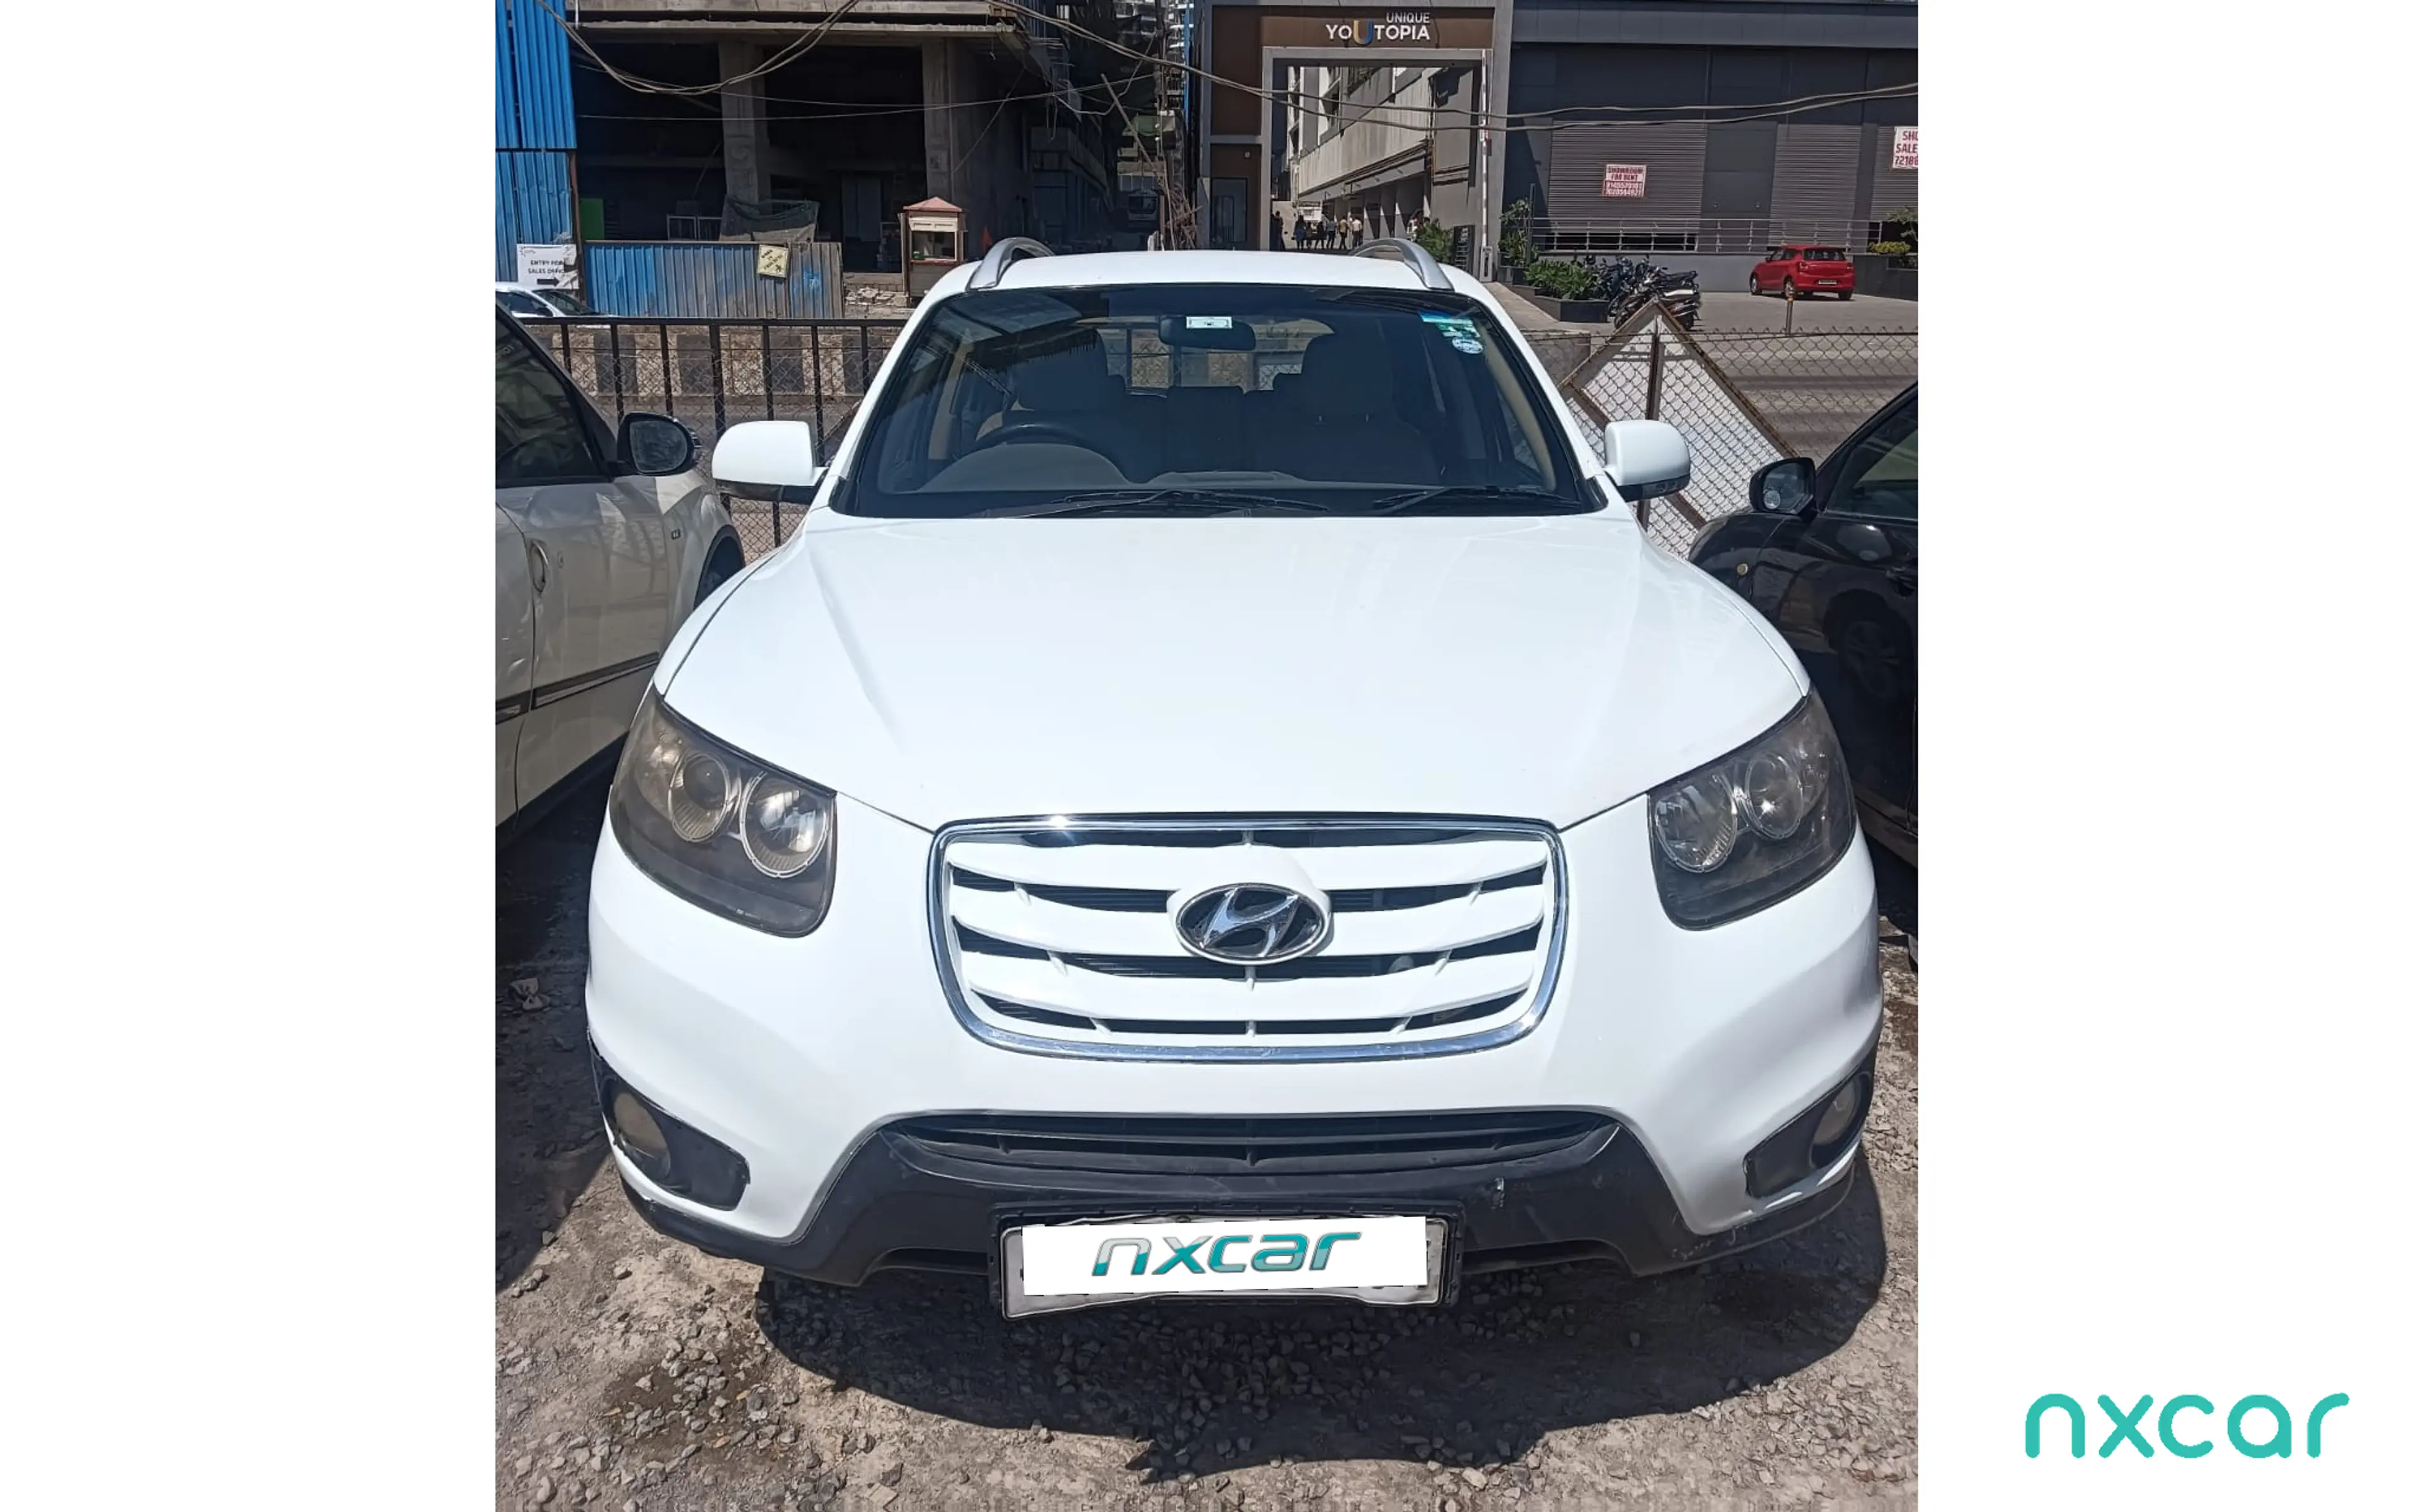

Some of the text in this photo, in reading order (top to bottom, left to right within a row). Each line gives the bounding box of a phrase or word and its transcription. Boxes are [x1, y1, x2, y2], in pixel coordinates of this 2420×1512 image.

[1386, 12, 1430, 23] UNIQUE
[1325, 20, 1431, 45] YOUTOPIA
[1896, 143, 1918, 153] SALE
